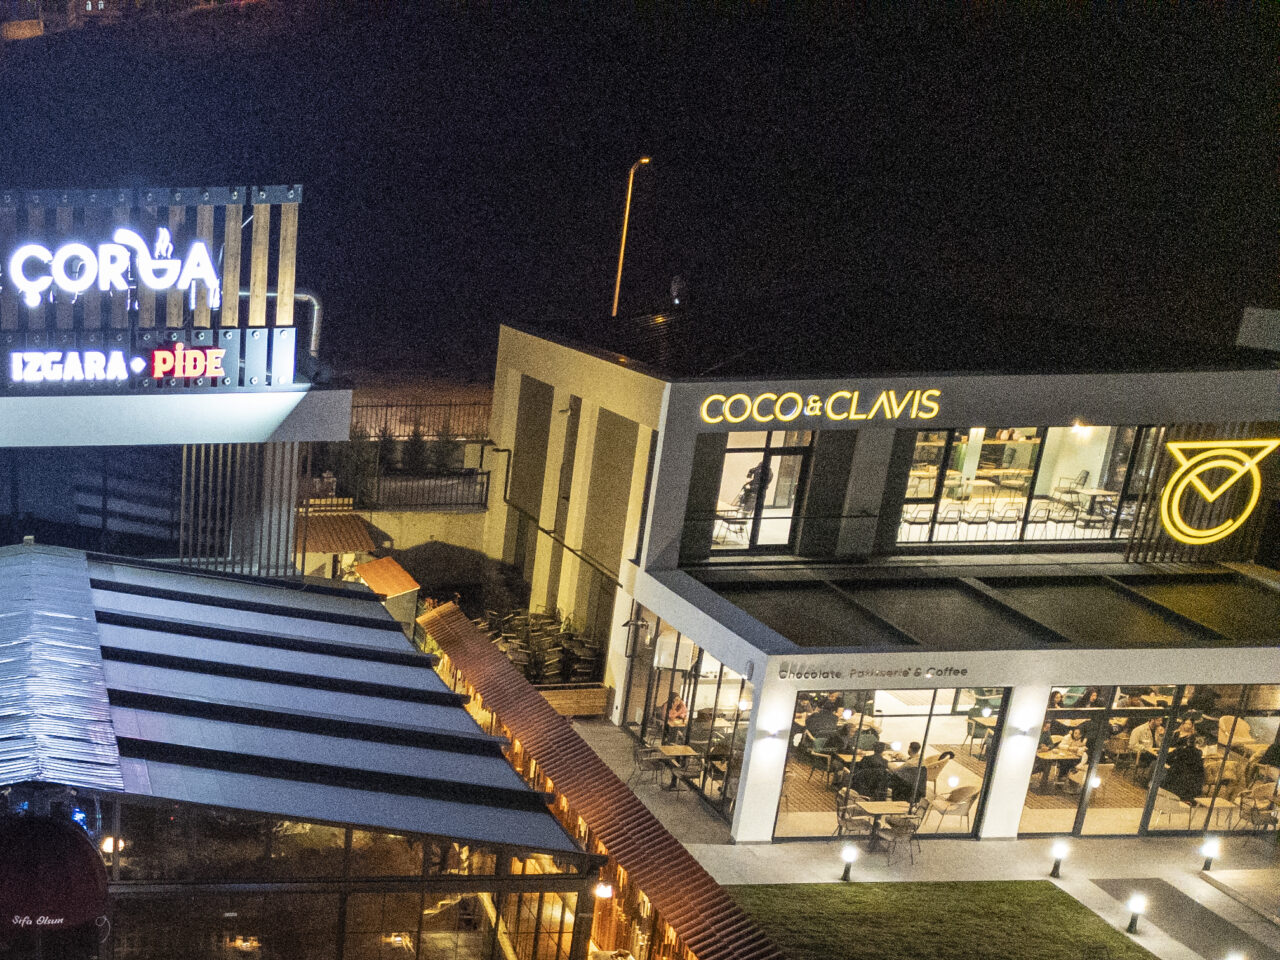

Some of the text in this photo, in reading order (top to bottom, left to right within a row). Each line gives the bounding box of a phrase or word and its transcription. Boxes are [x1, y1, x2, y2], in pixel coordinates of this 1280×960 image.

[10, 342, 226, 382] IZGARA PİDE
[925, 666, 969, 678] Coffee
[36, 915, 64, 926] Olsun
